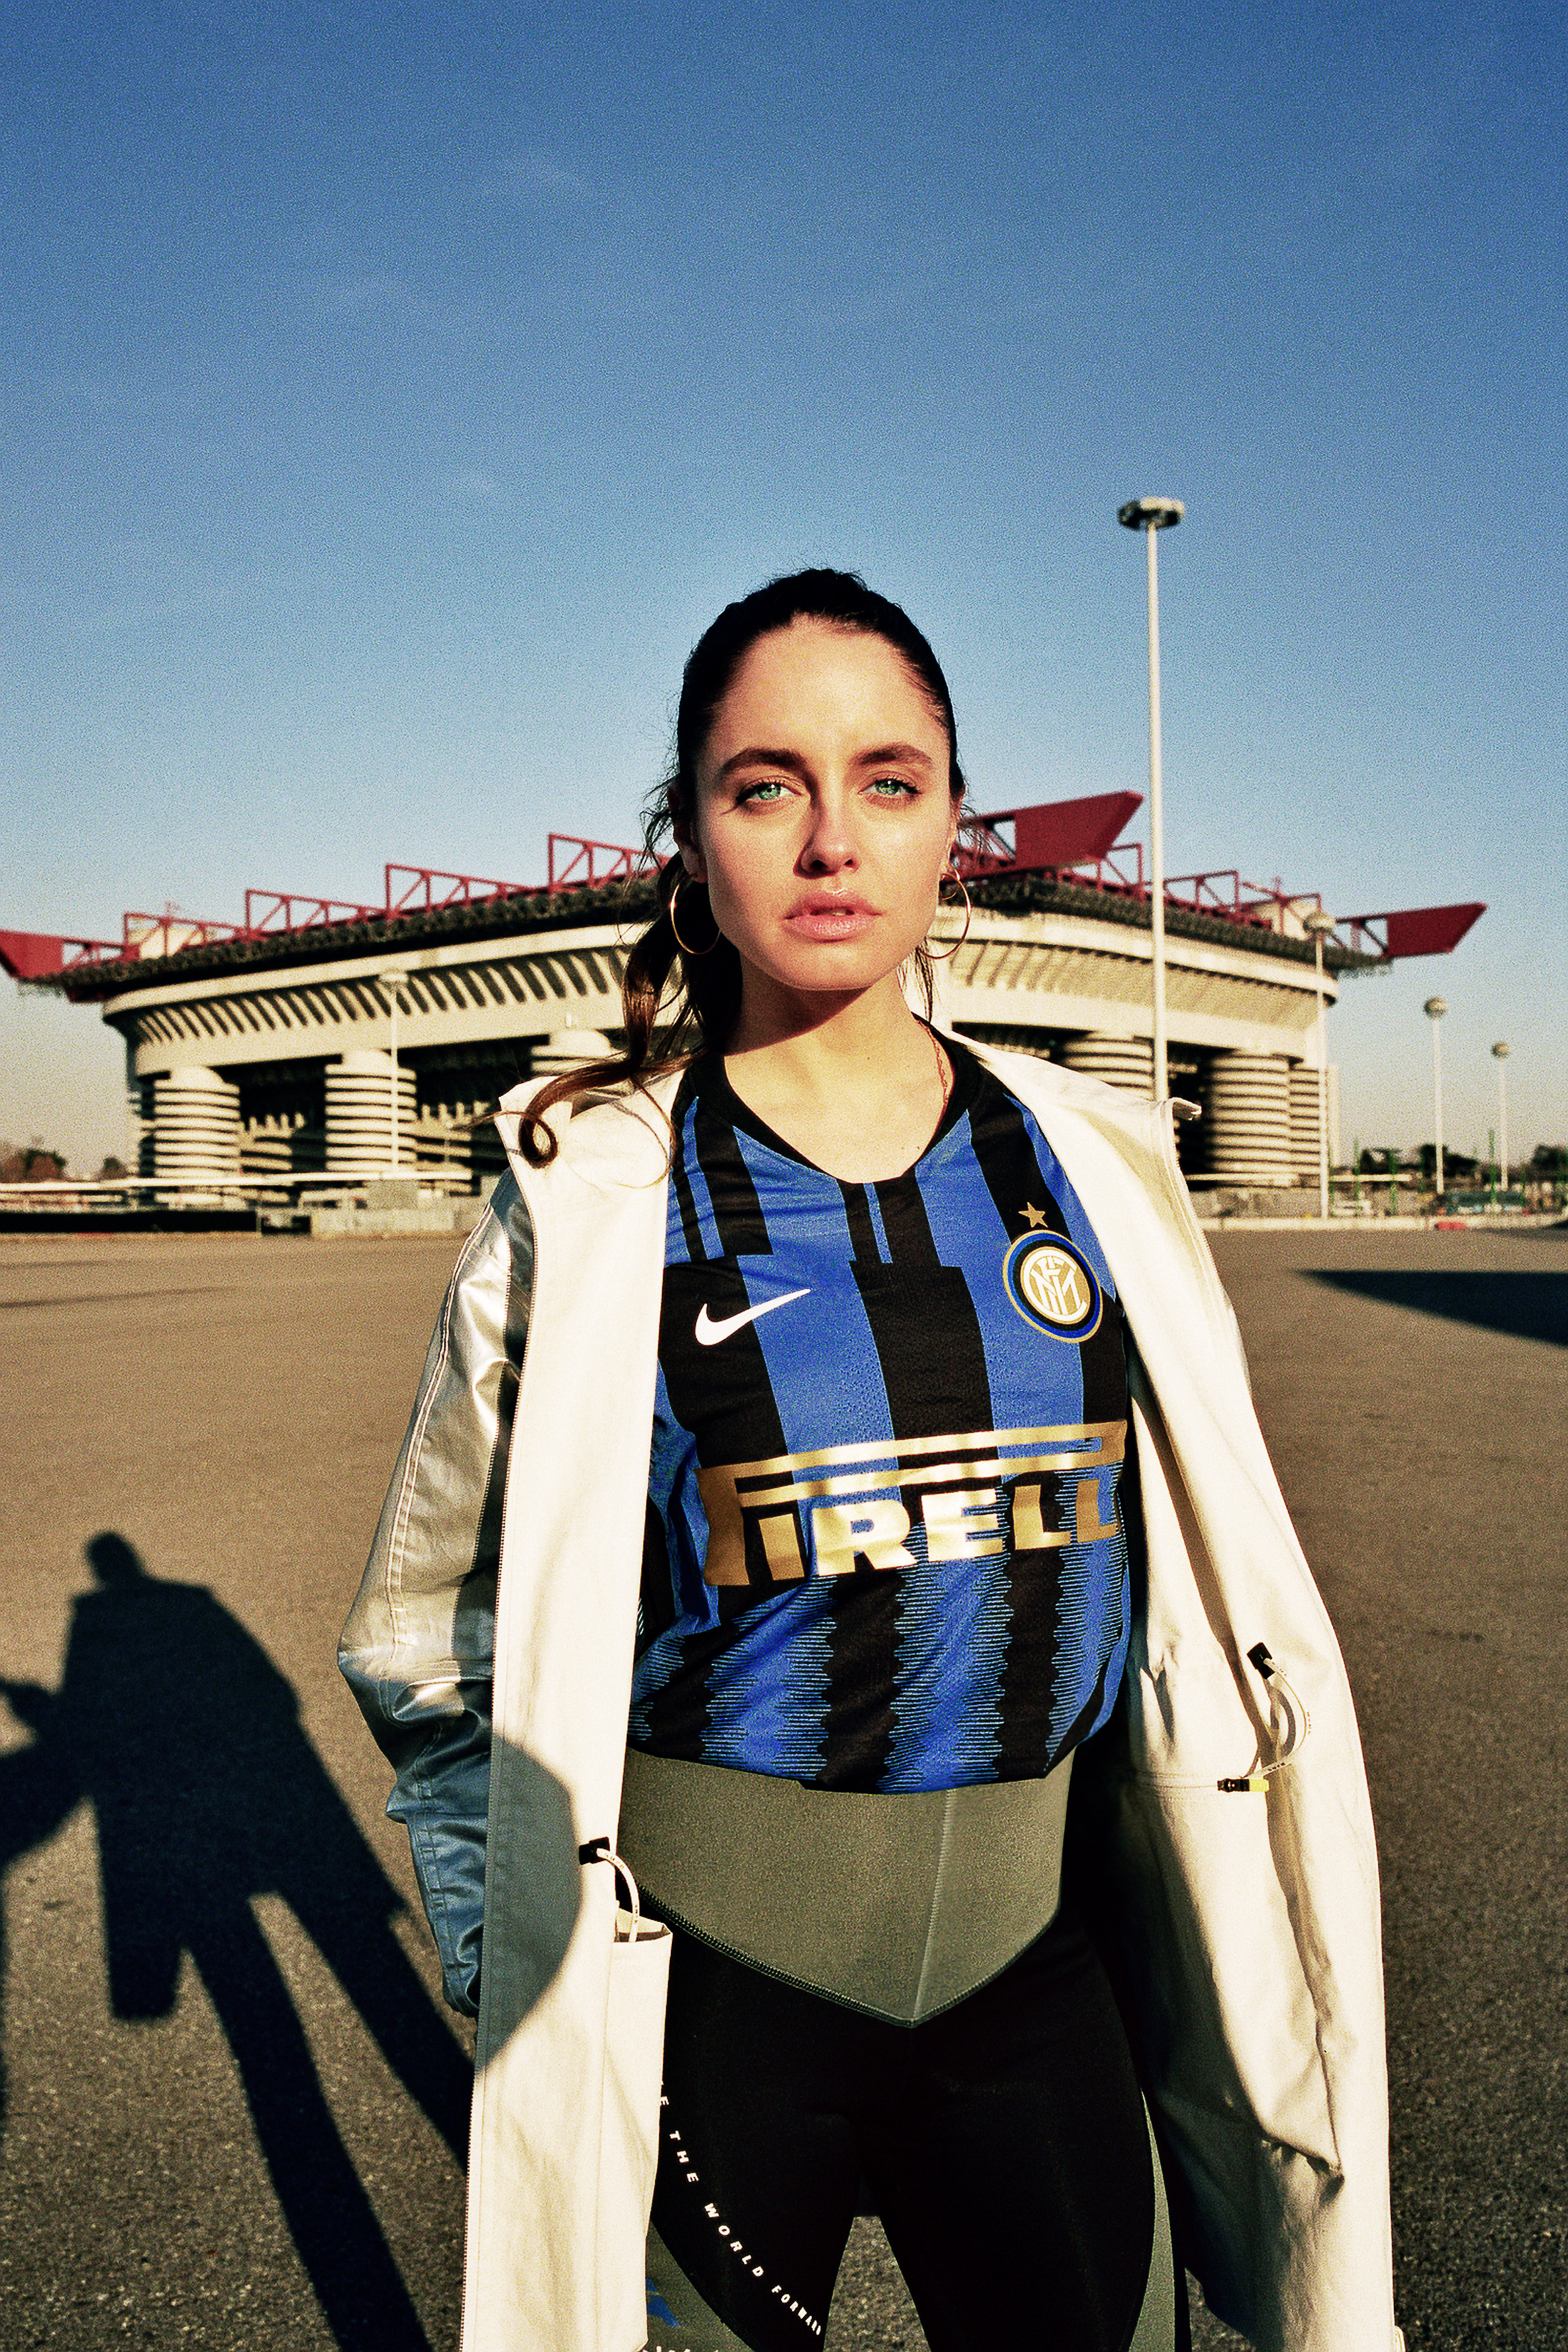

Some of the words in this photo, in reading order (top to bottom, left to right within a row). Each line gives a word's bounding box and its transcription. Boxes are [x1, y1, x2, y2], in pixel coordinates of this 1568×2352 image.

[694, 1420, 1128, 1586] PIRELL
[669, 2130, 699, 2182] THE
[704, 2203, 764, 2277] WORLD
